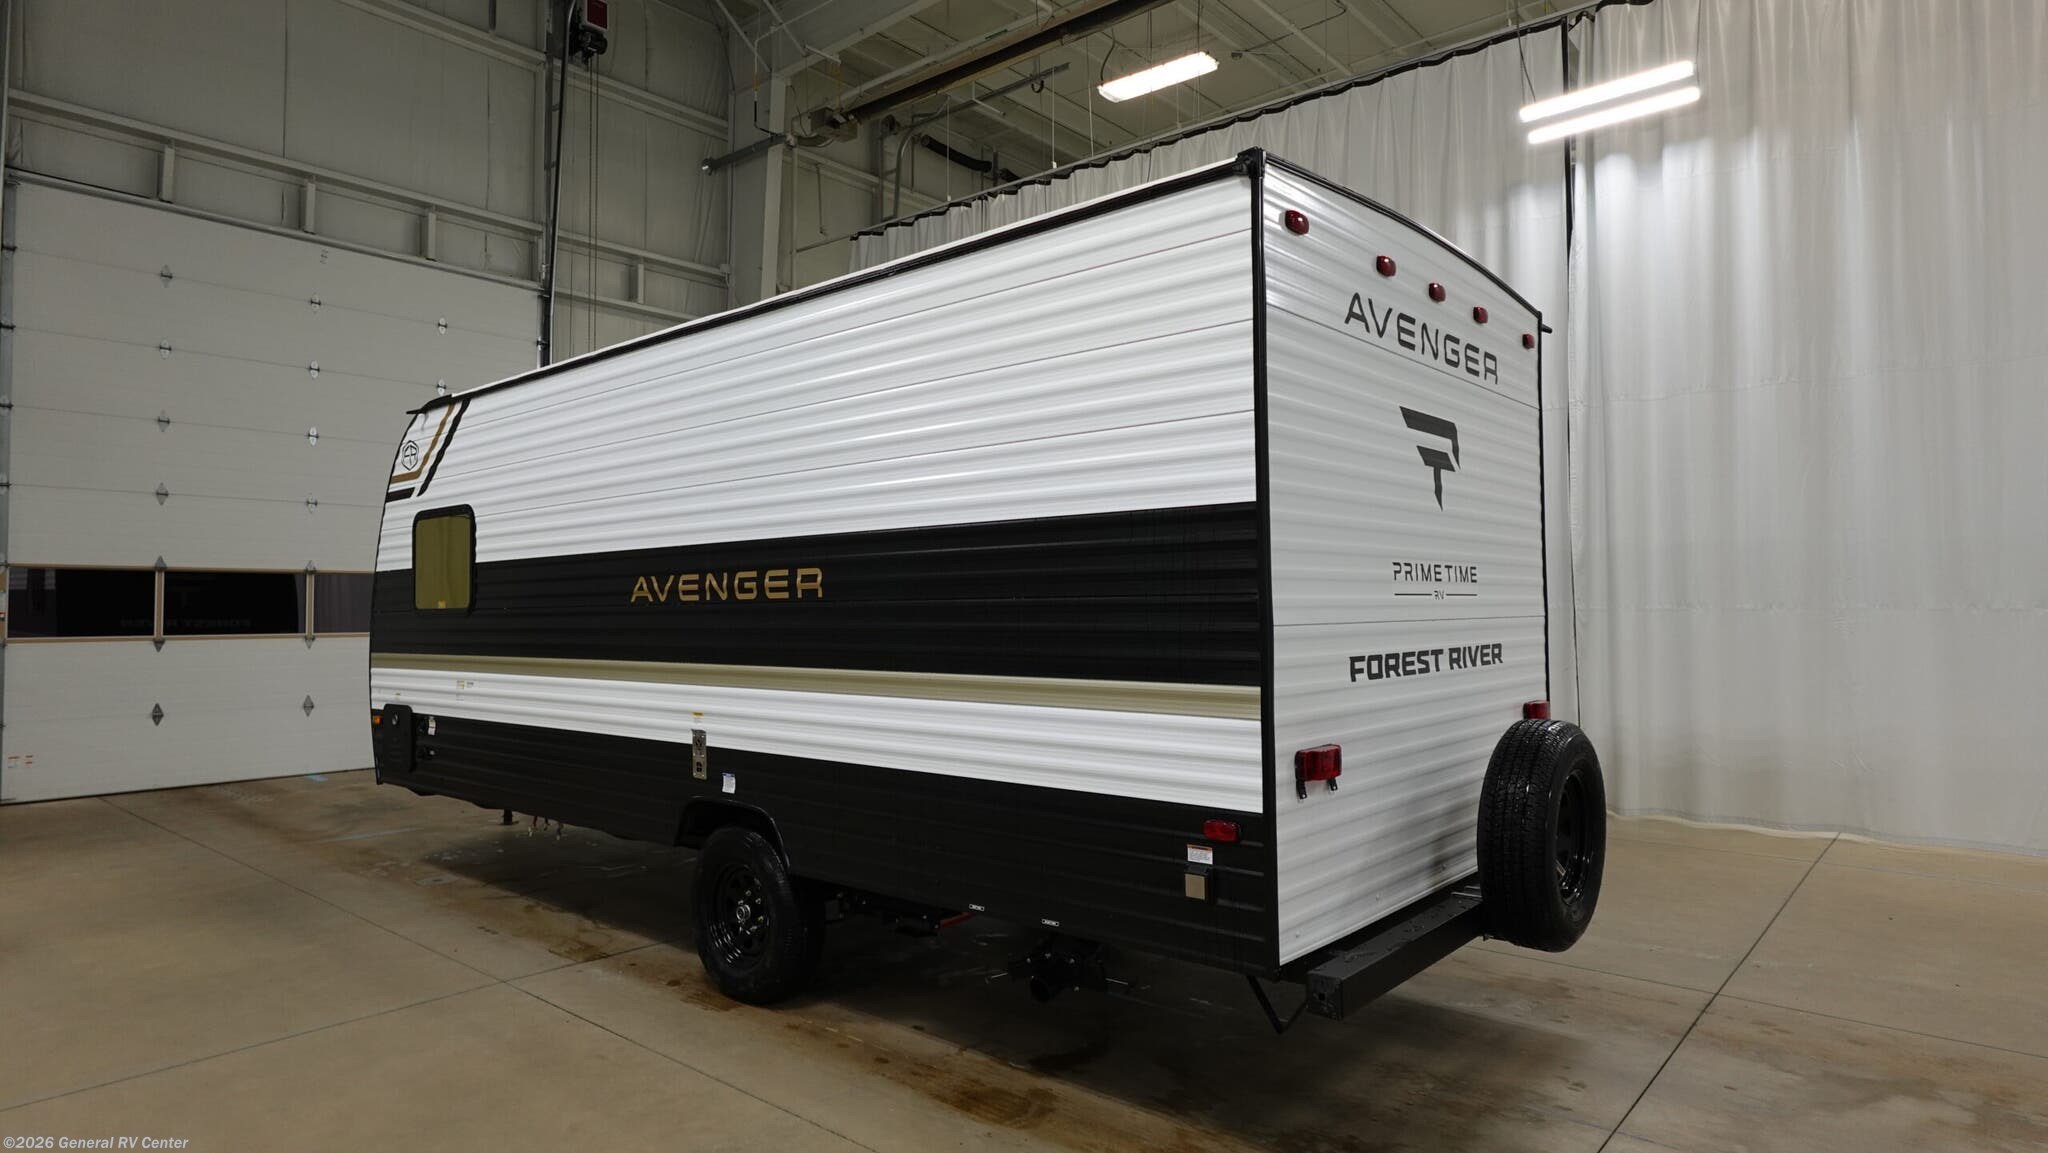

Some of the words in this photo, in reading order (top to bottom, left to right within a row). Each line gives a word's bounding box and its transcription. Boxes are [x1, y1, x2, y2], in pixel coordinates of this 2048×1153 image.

[1345, 292, 1497, 384] AVENGER
[630, 567, 824, 604] AVENGER
[1433, 590, 1446, 600] RV
[1349, 648, 1444, 683] FOREST
[1448, 643, 1503, 671] RIVER
